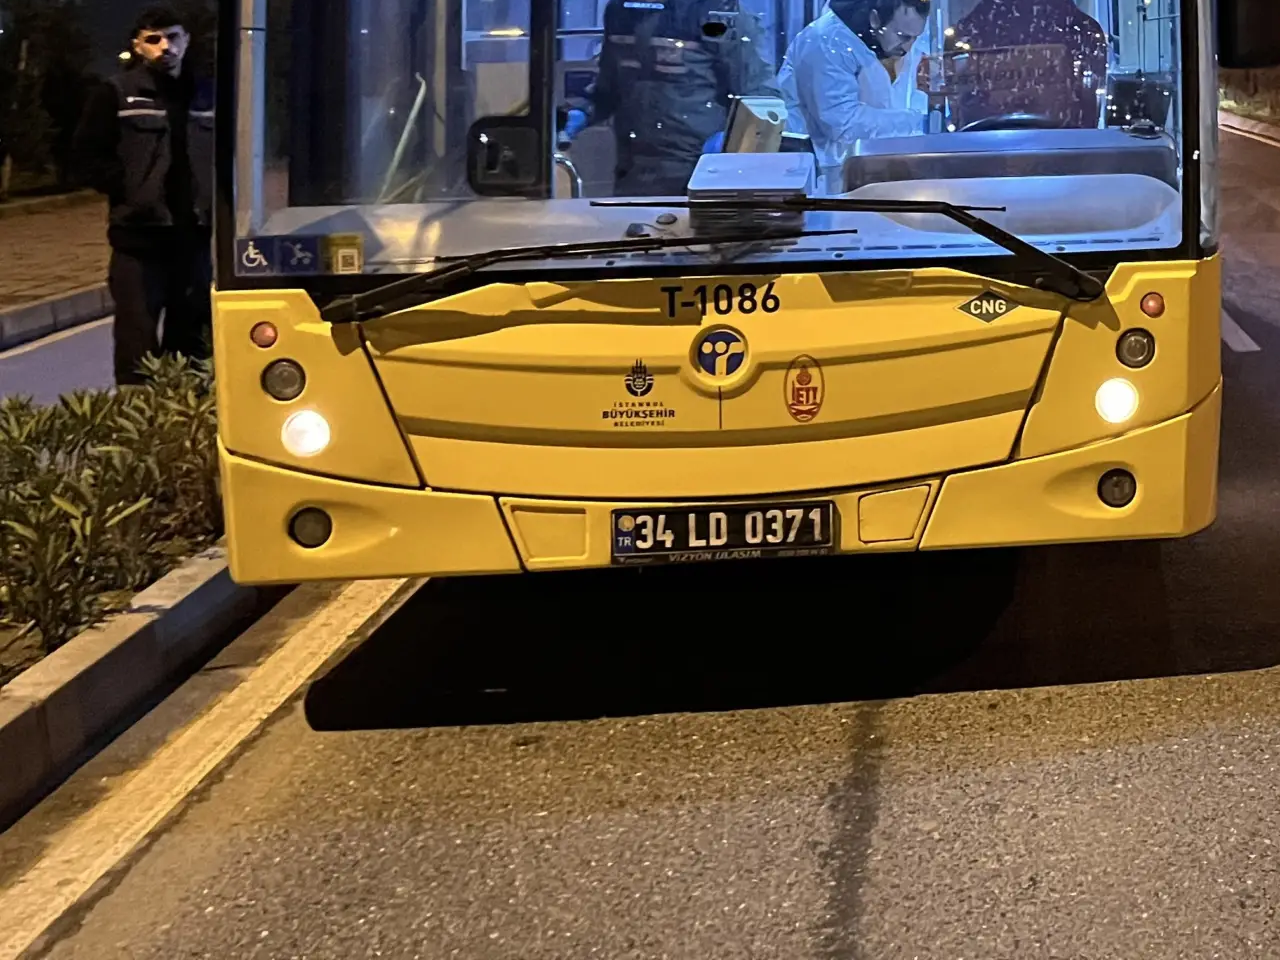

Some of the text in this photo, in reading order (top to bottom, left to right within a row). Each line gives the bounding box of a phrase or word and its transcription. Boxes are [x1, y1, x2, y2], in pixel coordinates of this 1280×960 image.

[661, 282, 780, 318] T-1086
[970, 300, 1007, 314] CNG
[602, 408, 676, 419] BÜYÜKŞEHİR
[635, 508, 822, 549] 34 LD 0371
[617, 537, 632, 547] TR
